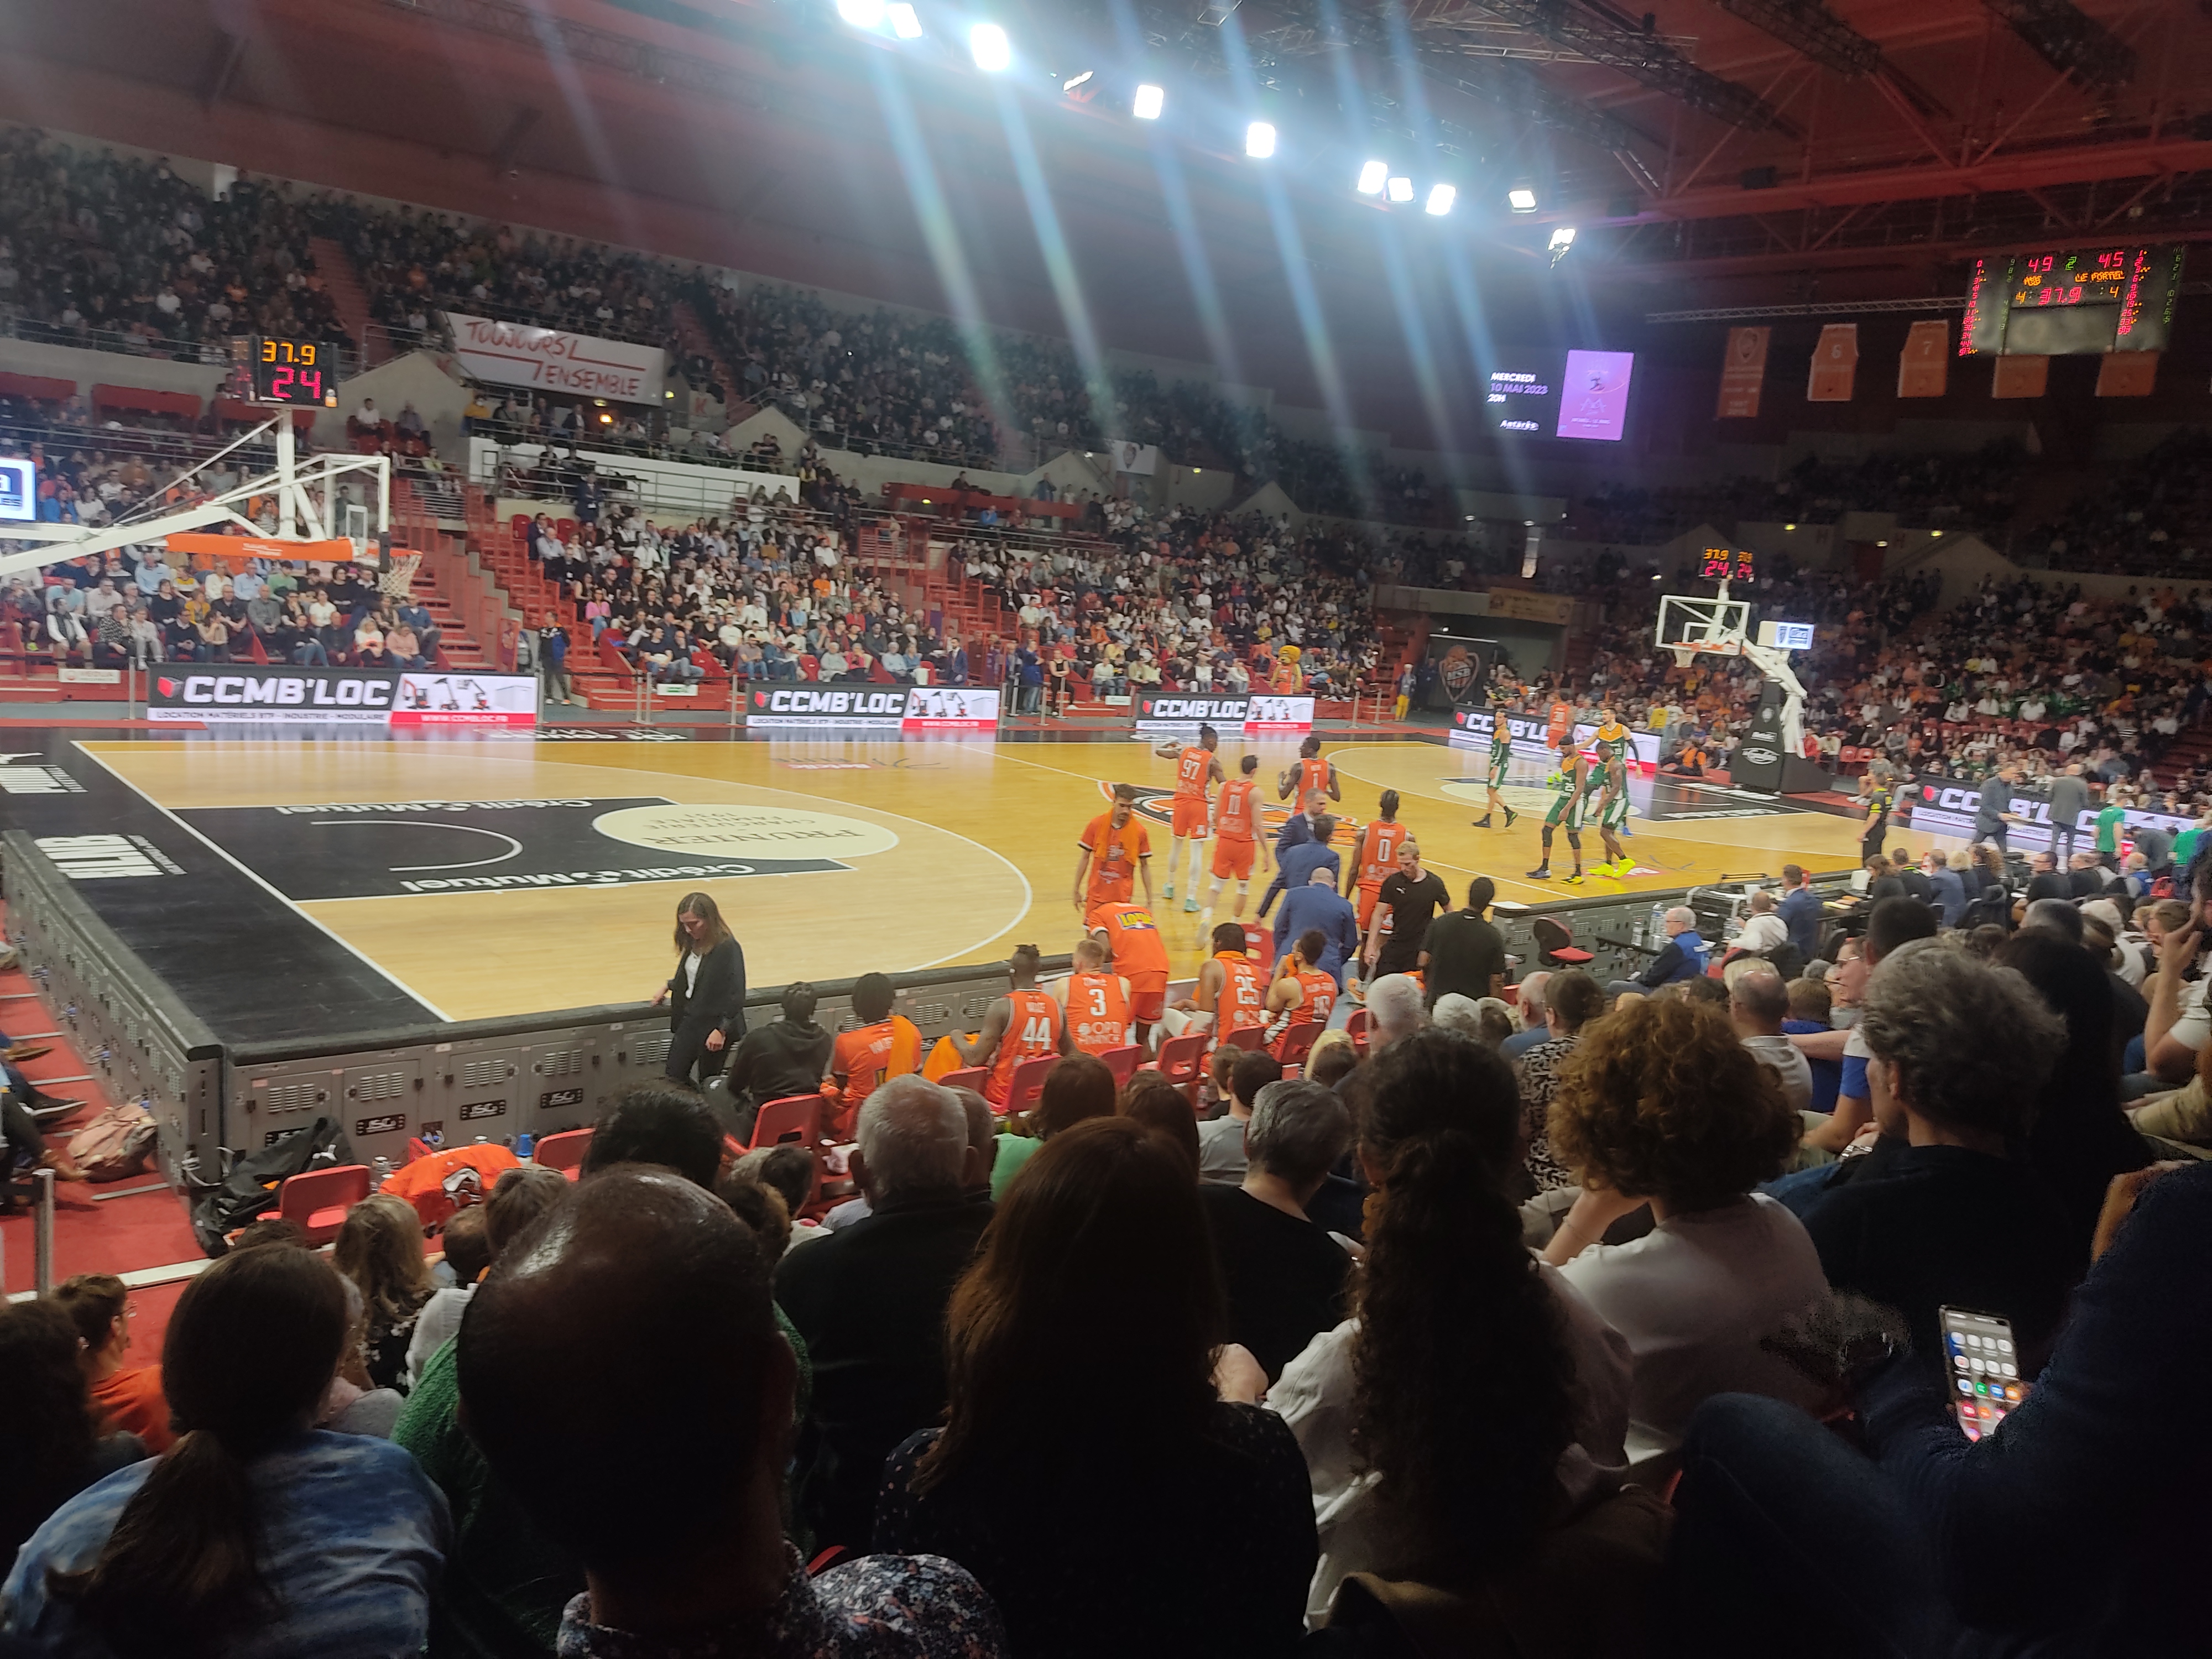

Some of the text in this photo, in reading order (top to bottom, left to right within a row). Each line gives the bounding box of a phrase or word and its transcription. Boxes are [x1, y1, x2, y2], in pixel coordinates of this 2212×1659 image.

[2028, 256, 2053, 273] 49
[2065, 257, 2077, 270] 2
[2099, 252, 2124, 268] 45
[2023, 275, 2042, 286] MSB
[2075, 270, 2125, 282] LE PORTEL
[2038, 286, 2081, 305] 37.9
[2109, 286, 2119, 298] 4
[464, 321, 569, 358] TOUJOURS
[262, 340, 316, 366] 37.9
[1832, 345, 1841, 358] 6
[273, 366, 322, 399] 24
[545, 365, 641, 397] ENSEMBLE
[1490, 372, 1536, 383] MERCREDI
[1490, 383, 1501, 392] 10
[1502, 384, 1523, 394] MAI
[1705, 561, 1730, 576] 24
[183, 676, 392, 706] CCMB'LOC
[771, 690, 906, 714] CCMB'LOC
[1152, 699, 1248, 718] CCMB'LOC
[1181, 759, 1202, 780] 97
[275, 800, 593, 815] Crédit Mutuel
[1226, 794, 1241, 815] 11
[643, 819, 816, 830] CHARCUTERIE
[642, 829, 866, 845] PRUNIER
[1378, 838, 1391, 863] 0
[399, 863, 757, 892] Crédit Mutuel
[1234, 975, 1260, 1005] 25
[1089, 988, 1107, 1016] 3
[1021, 1016, 1052, 1050] 44
